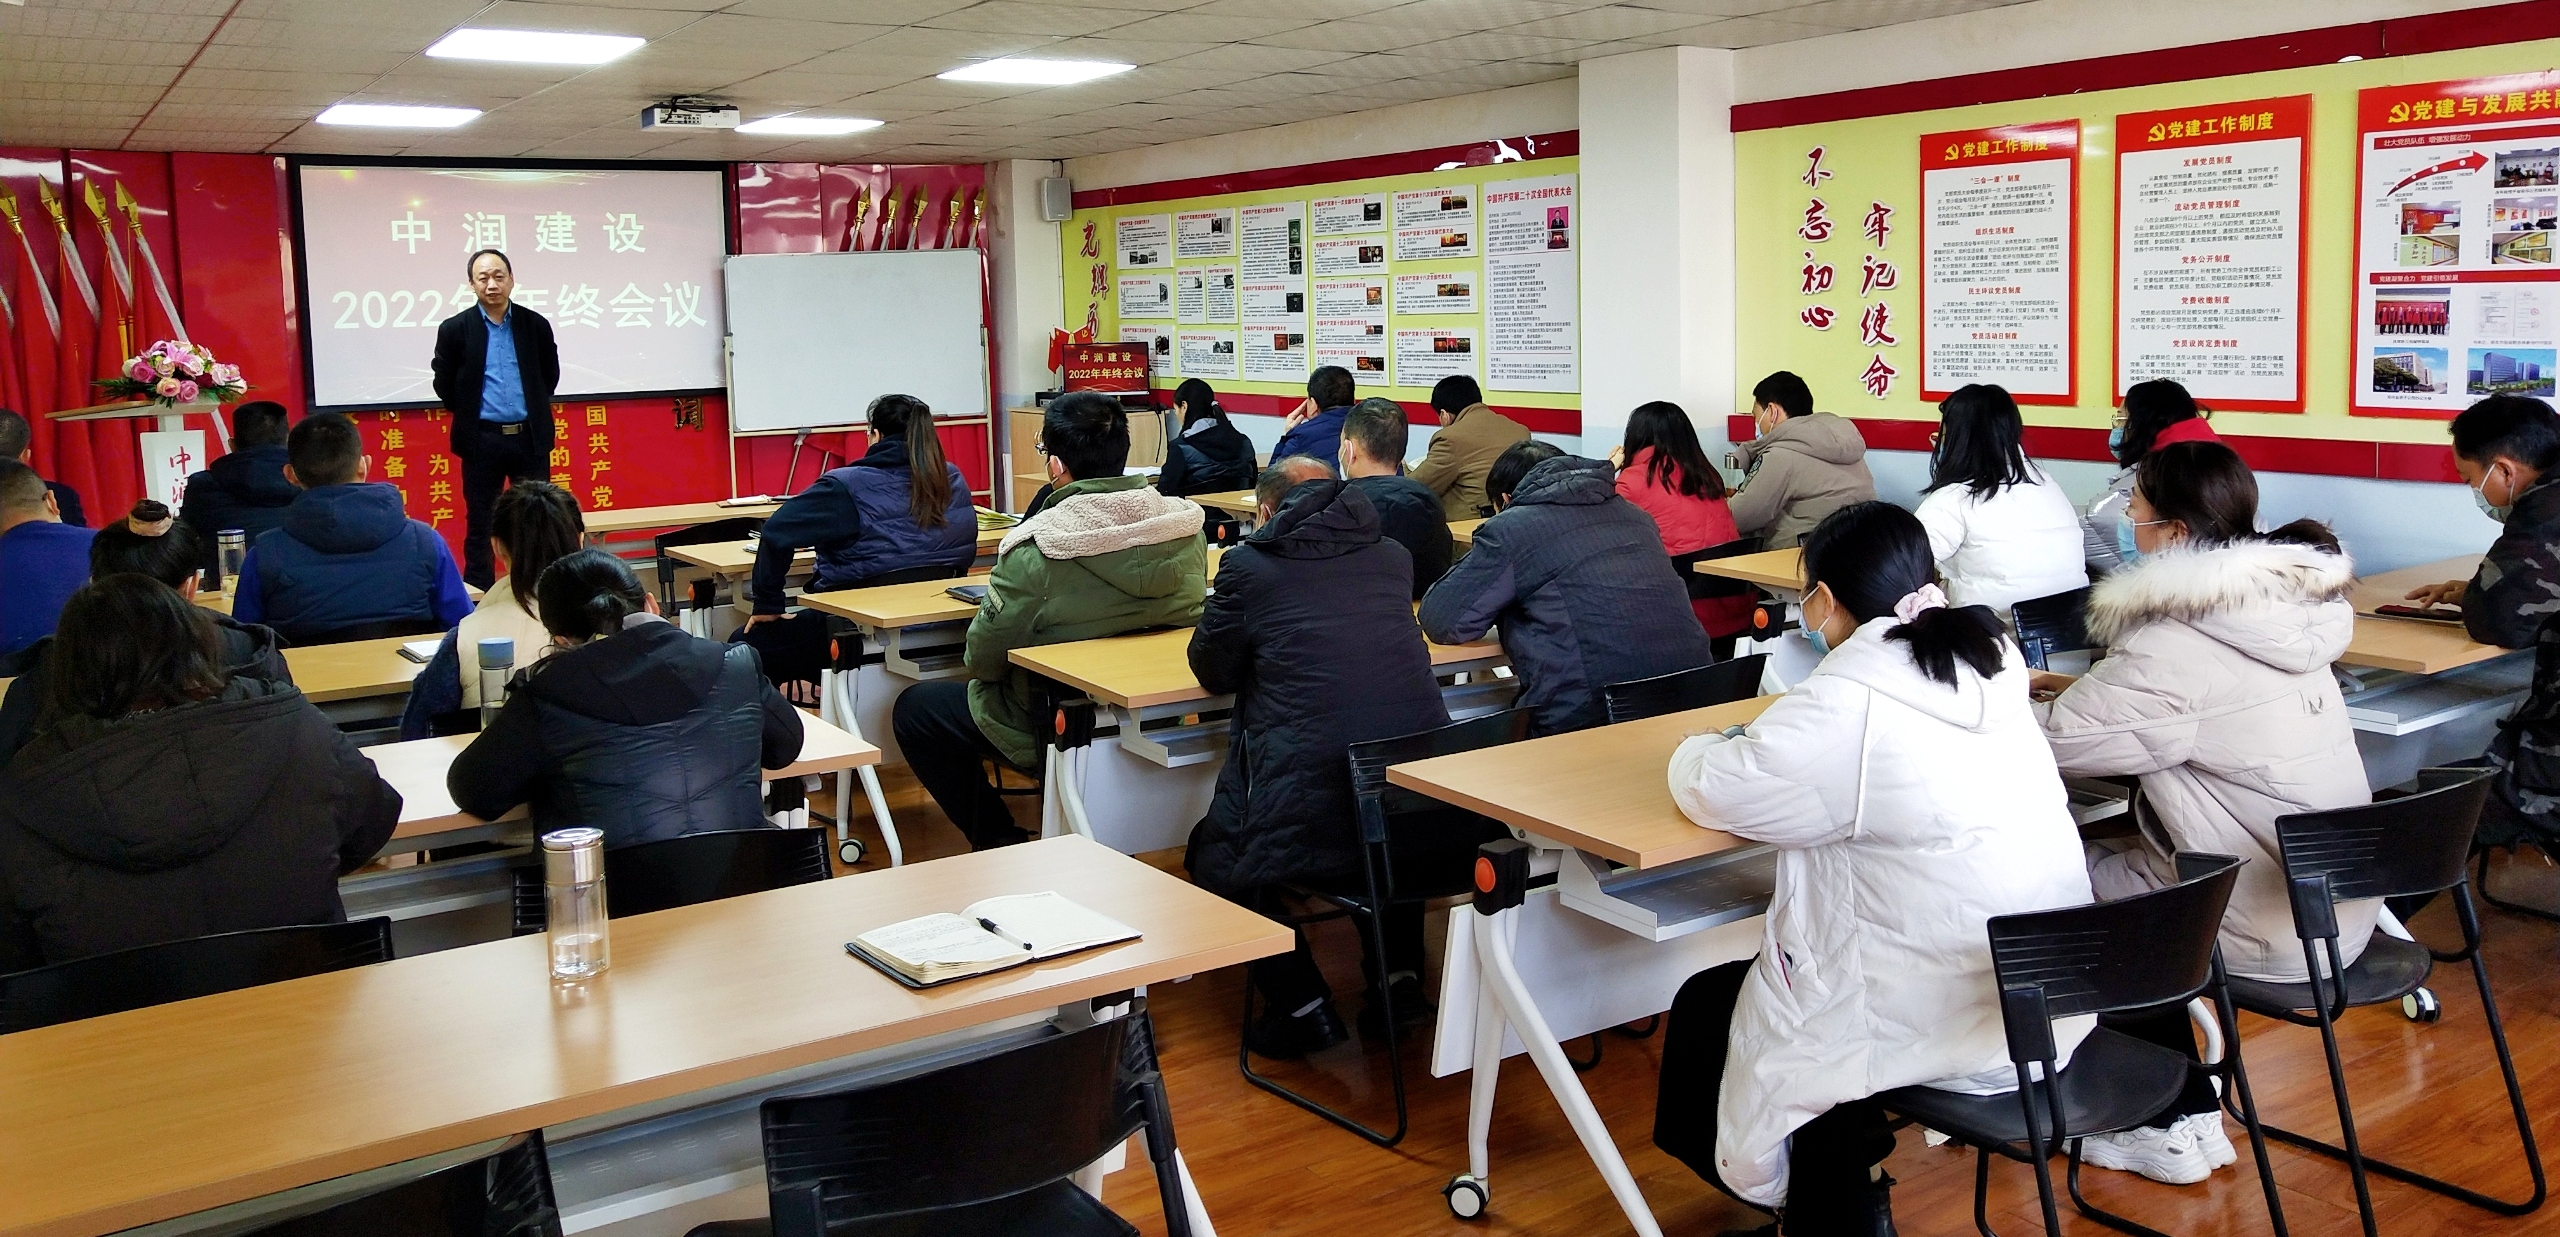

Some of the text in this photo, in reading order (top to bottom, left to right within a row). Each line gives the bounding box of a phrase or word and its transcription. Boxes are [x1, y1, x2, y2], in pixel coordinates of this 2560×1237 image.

[2412, 88, 2560, 121] 党建与发展共
[2168, 112, 2274, 139] 党建工作制度
[1962, 136, 2048, 158] 党建工作制度
[2383, 133, 2471, 147] 壮大党员队伍 增强发展动力
[2183, 155, 2233, 167] 发展党员制度
[1486, 186, 1572, 204] 中国共产党第二十次全国代表大会
[2174, 199, 2240, 211] 流动党员管理制度
[390, 210, 646, 254] 中润建设
[1798, 146, 1835, 330] 不忘初心
[1975, 226, 2015, 236] 组织生活制度
[2181, 254, 2231, 264] 党务公开制度
[1968, 286, 2021, 295] 民主评议党员制度
[1860, 201, 1899, 400] 牢记使命
[2181, 296, 2230, 305] 党费收缴制度
[1971, 332, 2018, 340] 党员活动日制度
[2172, 339, 2238, 348] 党员设岗定责制度
[1079, 351, 1132, 364] 中润建设
[1068, 366, 1145, 380] 2022年年终会议
[586, 404, 613, 509] 国共产党
